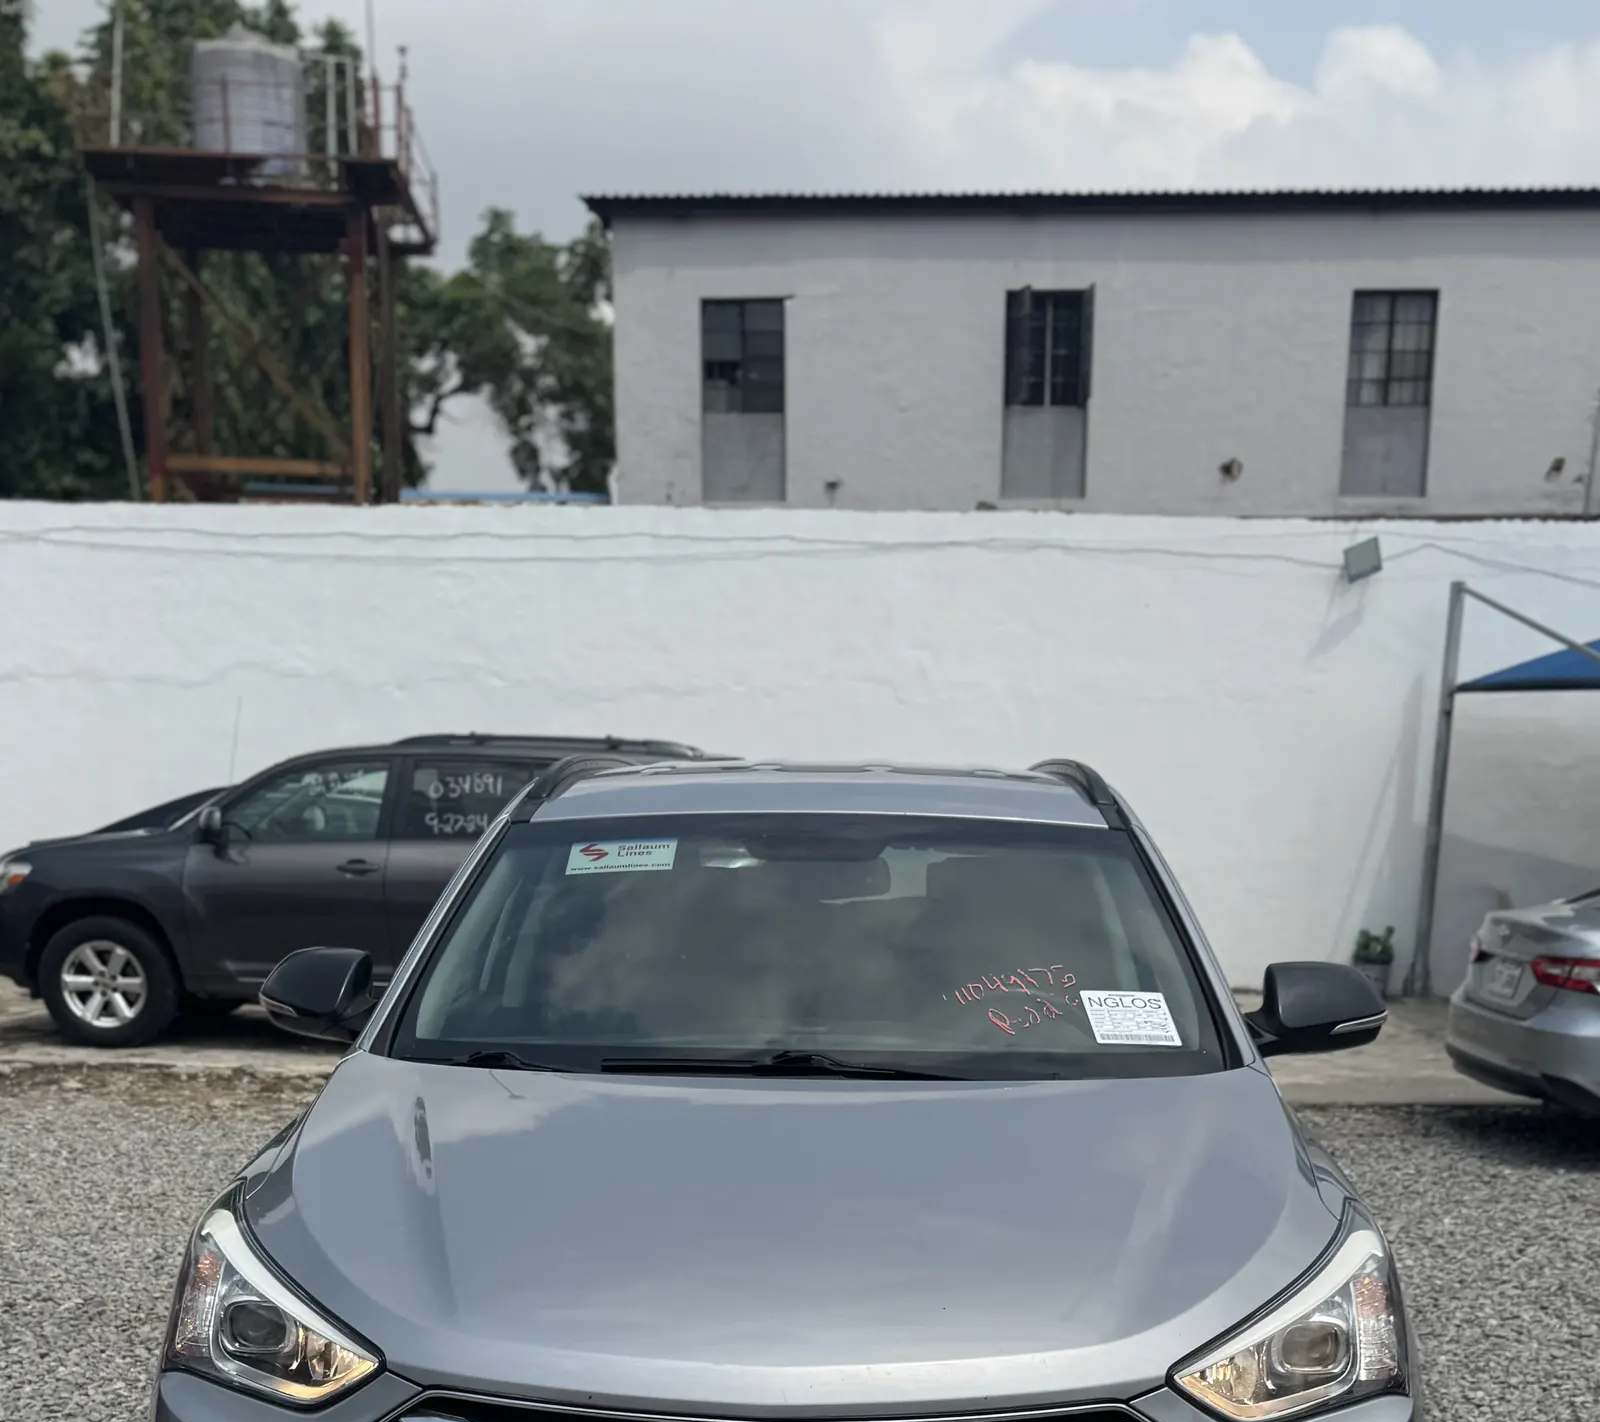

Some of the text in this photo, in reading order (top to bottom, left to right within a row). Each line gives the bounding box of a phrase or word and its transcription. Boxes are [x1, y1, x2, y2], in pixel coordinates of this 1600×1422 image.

[617, 843, 670, 852] Sallaum
[617, 849, 652, 858] Lines
[1087, 996, 1162, 1010] NGLOS
